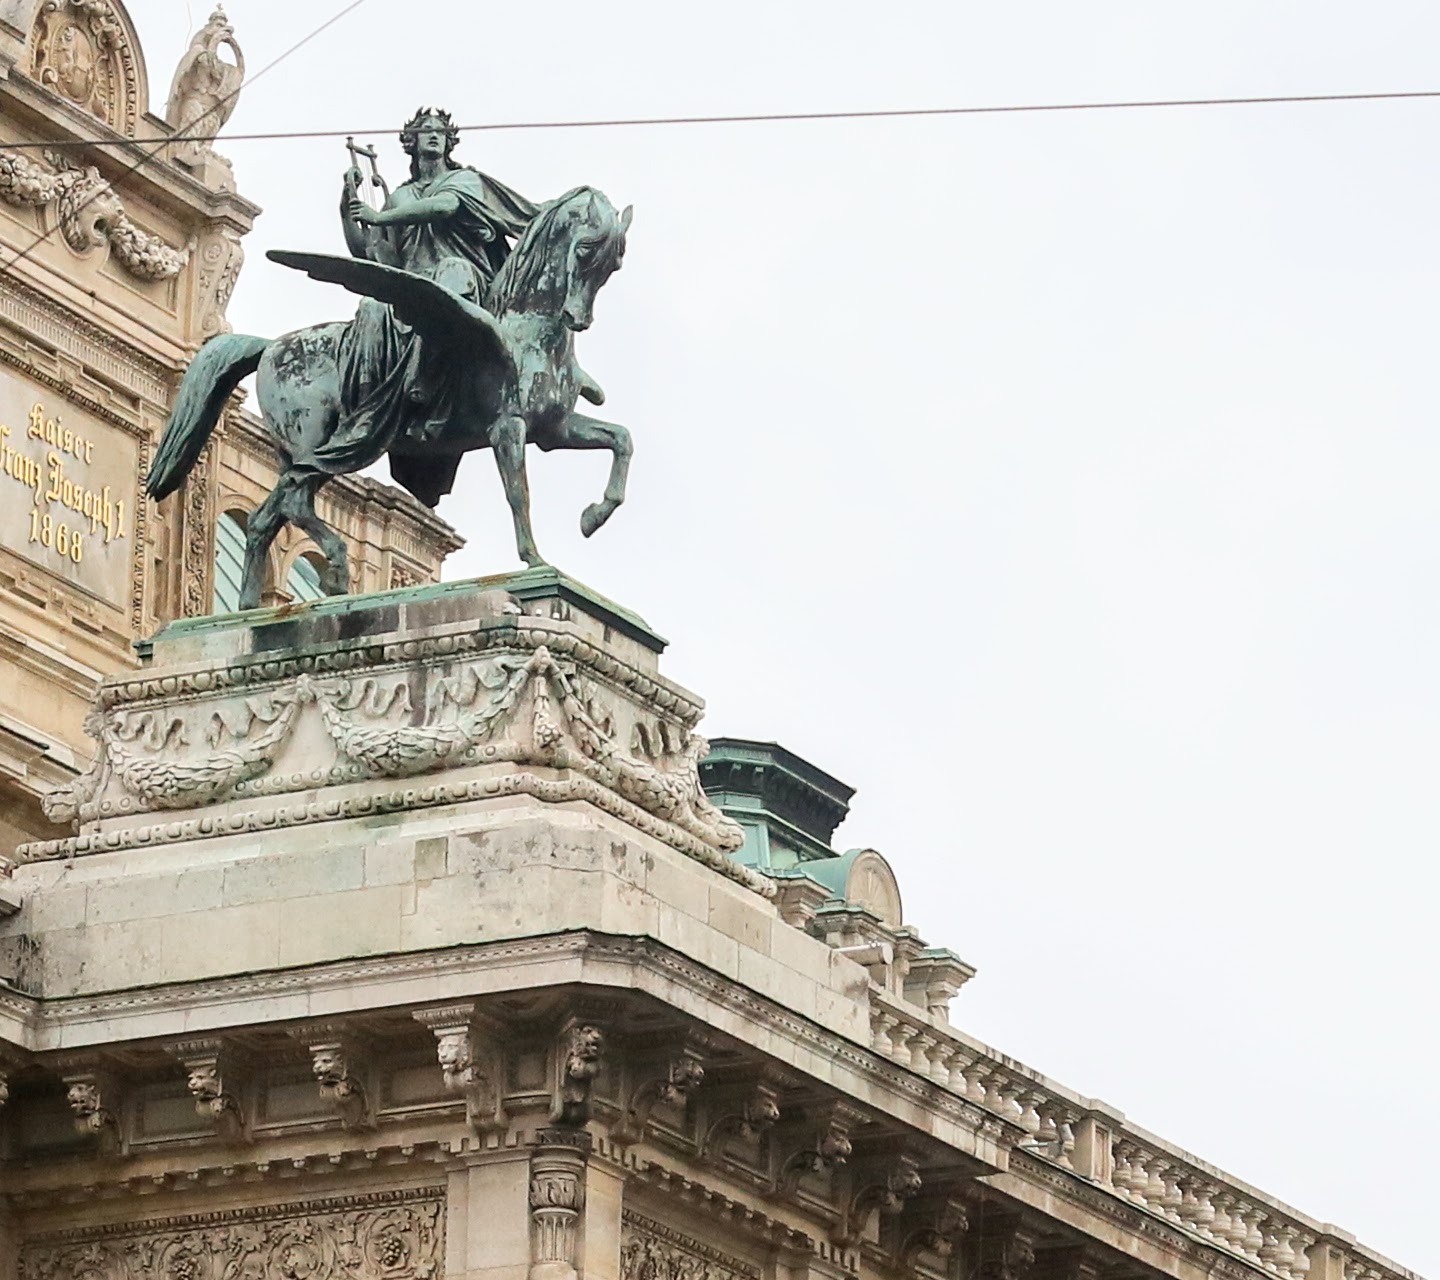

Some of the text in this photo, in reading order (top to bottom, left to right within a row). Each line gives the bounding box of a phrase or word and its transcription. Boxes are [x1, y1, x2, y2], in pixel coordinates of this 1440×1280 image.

[28, 402, 94, 464] Kaiser
[45, 452, 111, 543] Joseph
[29, 508, 83, 563] 1868
